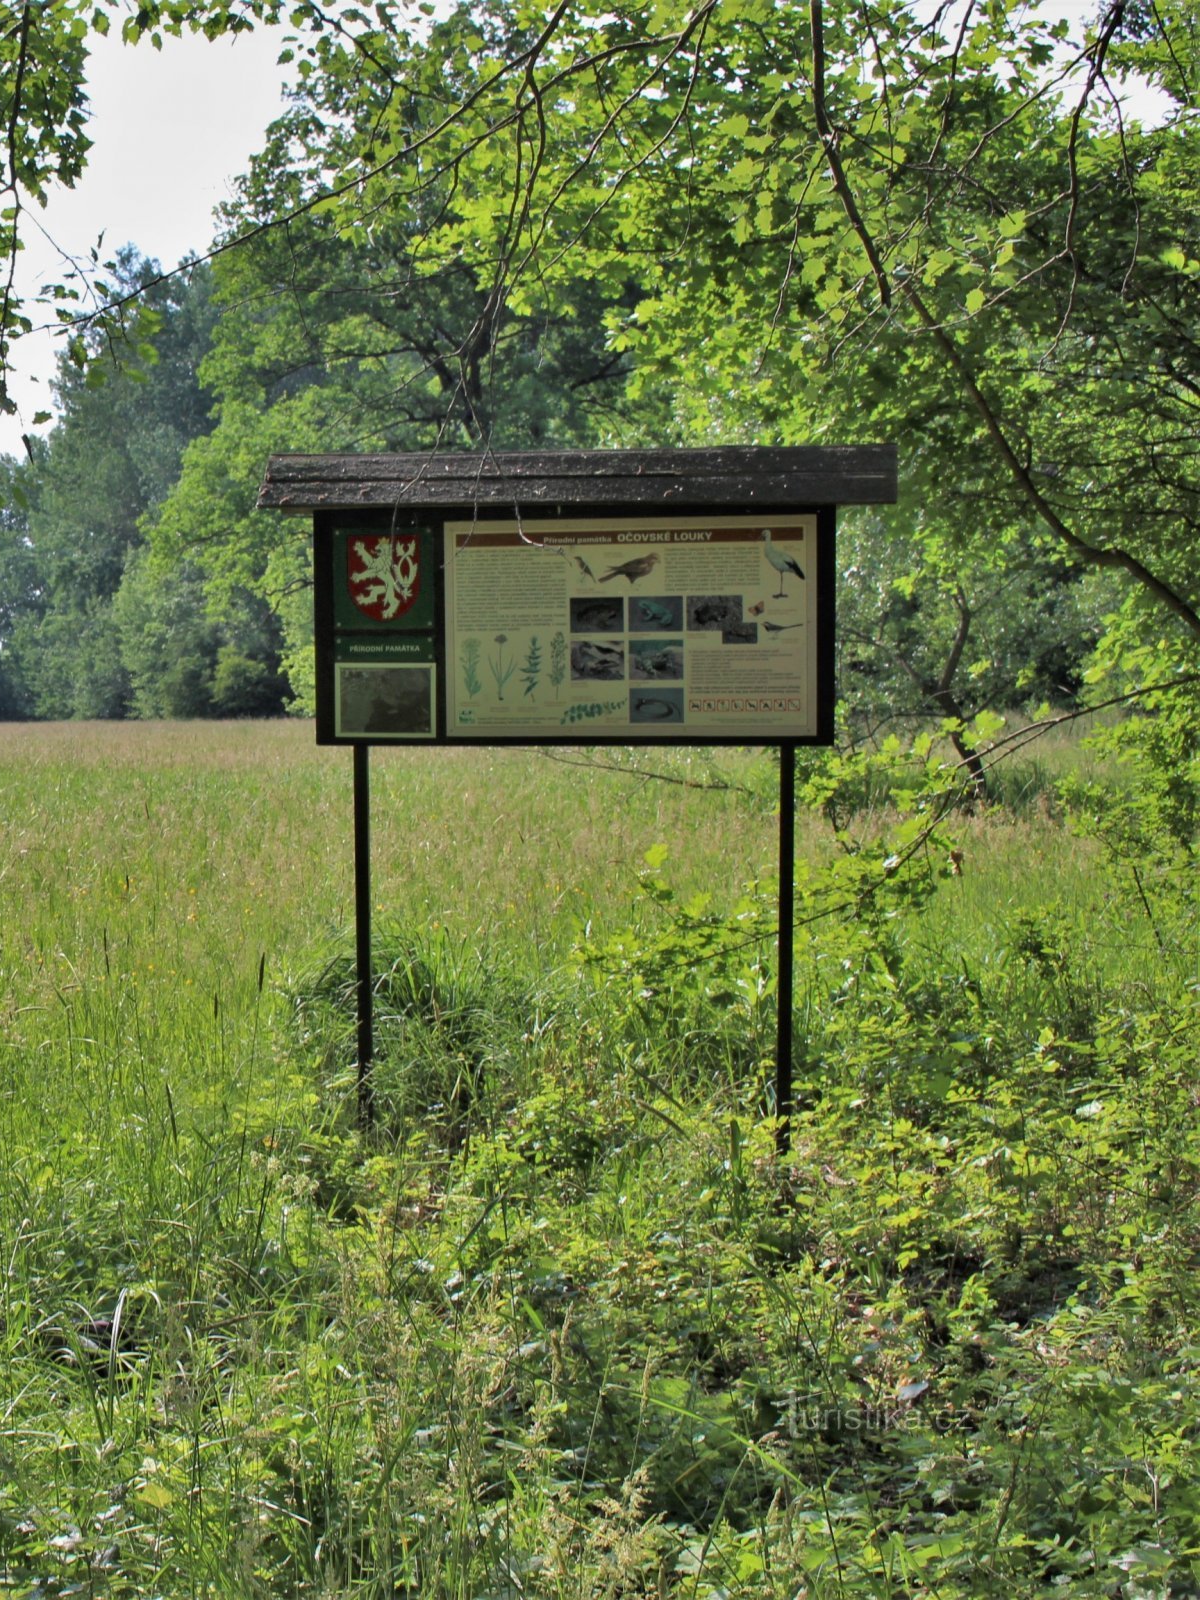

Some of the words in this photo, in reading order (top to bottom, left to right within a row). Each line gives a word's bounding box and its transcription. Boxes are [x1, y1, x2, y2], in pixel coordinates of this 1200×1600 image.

[543, 535, 575, 545] Přírodní
[577, 536, 612, 545] památka
[617, 530, 671, 542] OČOVSKÉ
[673, 531, 712, 541] LOUKY
[349, 644, 383, 653] PŘÍRODNÍ
[385, 644, 420, 653] PAMÁTKA
